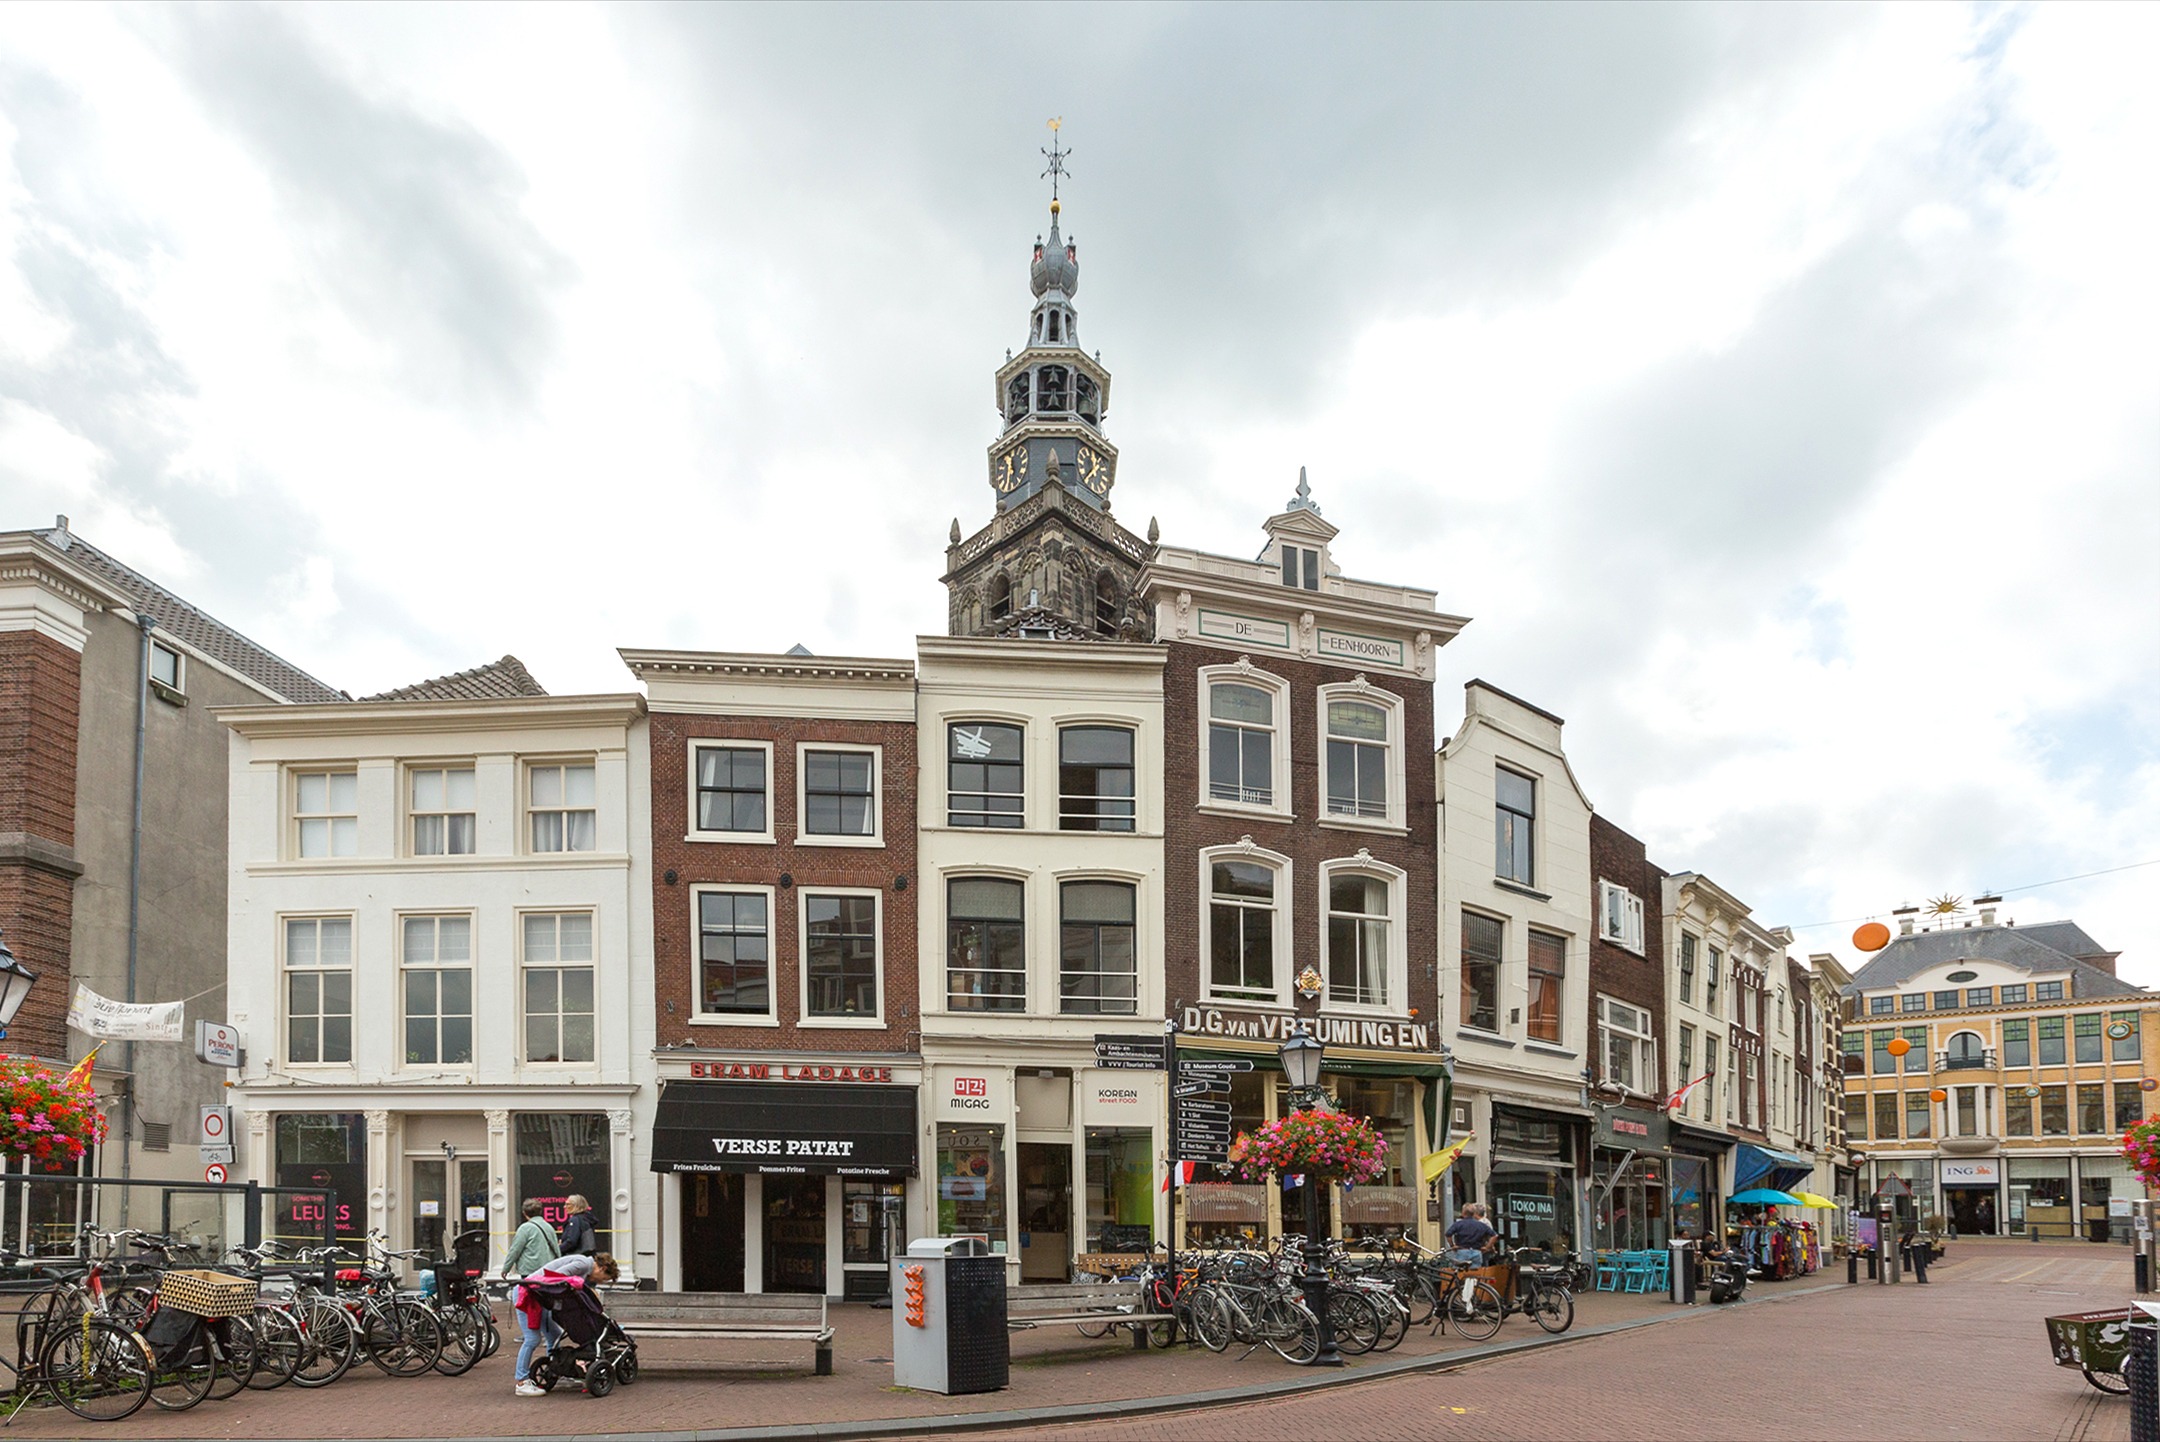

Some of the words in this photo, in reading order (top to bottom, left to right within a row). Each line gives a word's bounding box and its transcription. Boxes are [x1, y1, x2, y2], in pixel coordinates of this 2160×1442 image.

[1236, 622, 1252, 636] DE
[1330, 637, 1390, 657] EENHOORN
[1228, 1020, 1258, 1038] VAN
[1260, 1014, 1428, 1048] VREUMINGEN
[690, 1062, 770, 1080] BRAM
[782, 1064, 892, 1082] LADAGE
[956, 1079, 985, 1095] 미각
[1098, 1089, 1137, 1098] KOREAN
[950, 1098, 990, 1109] MIGAG
[712, 1138, 780, 1155] VERSE
[786, 1140, 854, 1156] PATAT
[1947, 1167, 1973, 1175] ING
[1512, 1200, 1536, 1212] TOKO
[1538, 1202, 1552, 1213] INA
